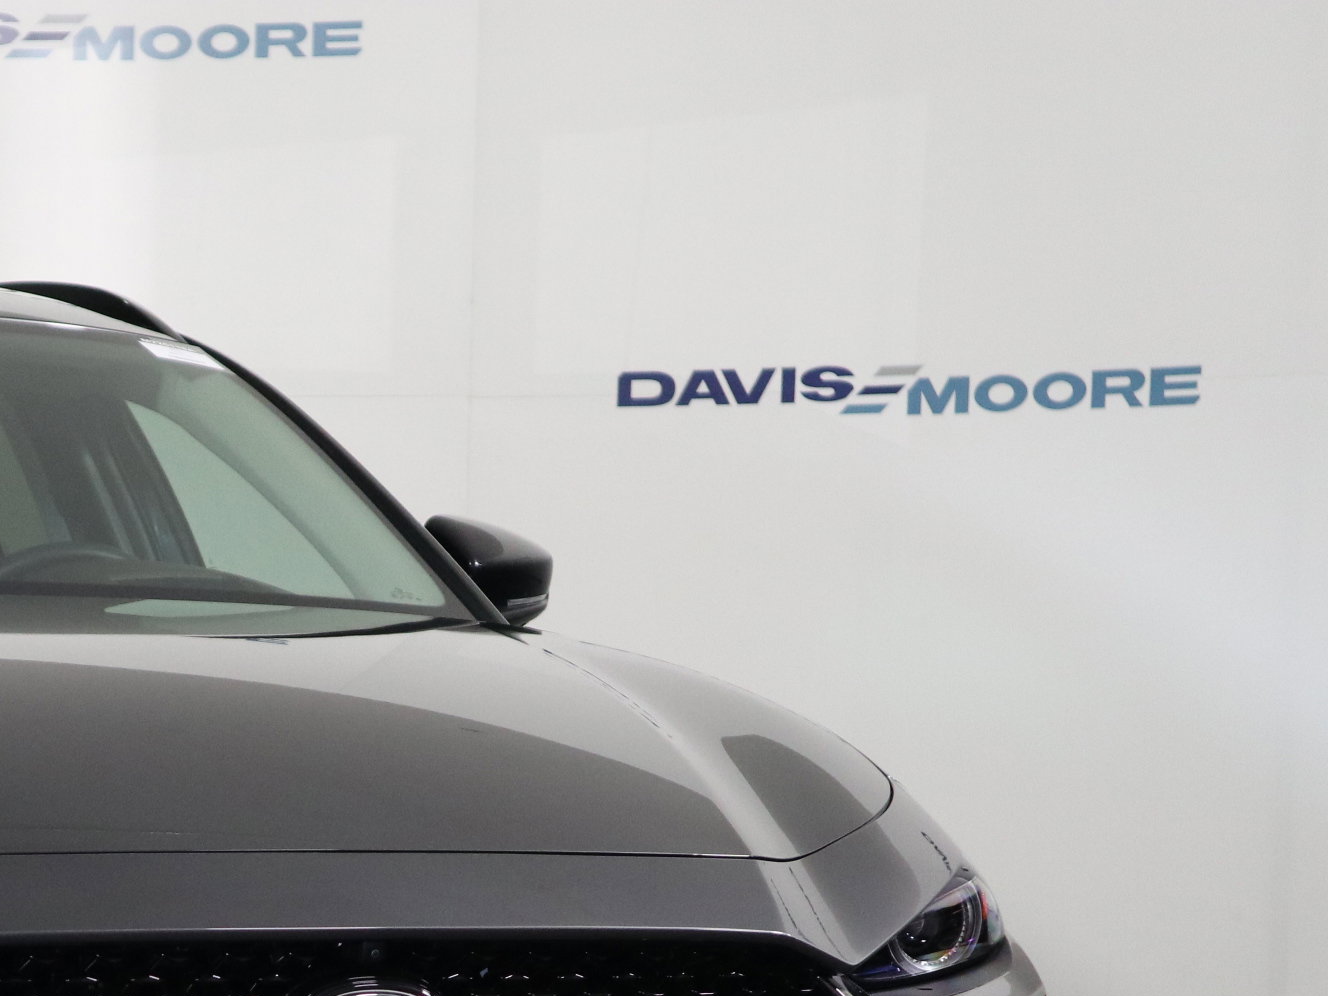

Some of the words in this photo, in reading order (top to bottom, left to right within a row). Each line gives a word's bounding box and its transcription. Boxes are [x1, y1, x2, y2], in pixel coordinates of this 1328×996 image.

[71, 19, 364, 61] MOORE
[615, 365, 855, 409] DAVIS
[906, 364, 1203, 417] MOORE
